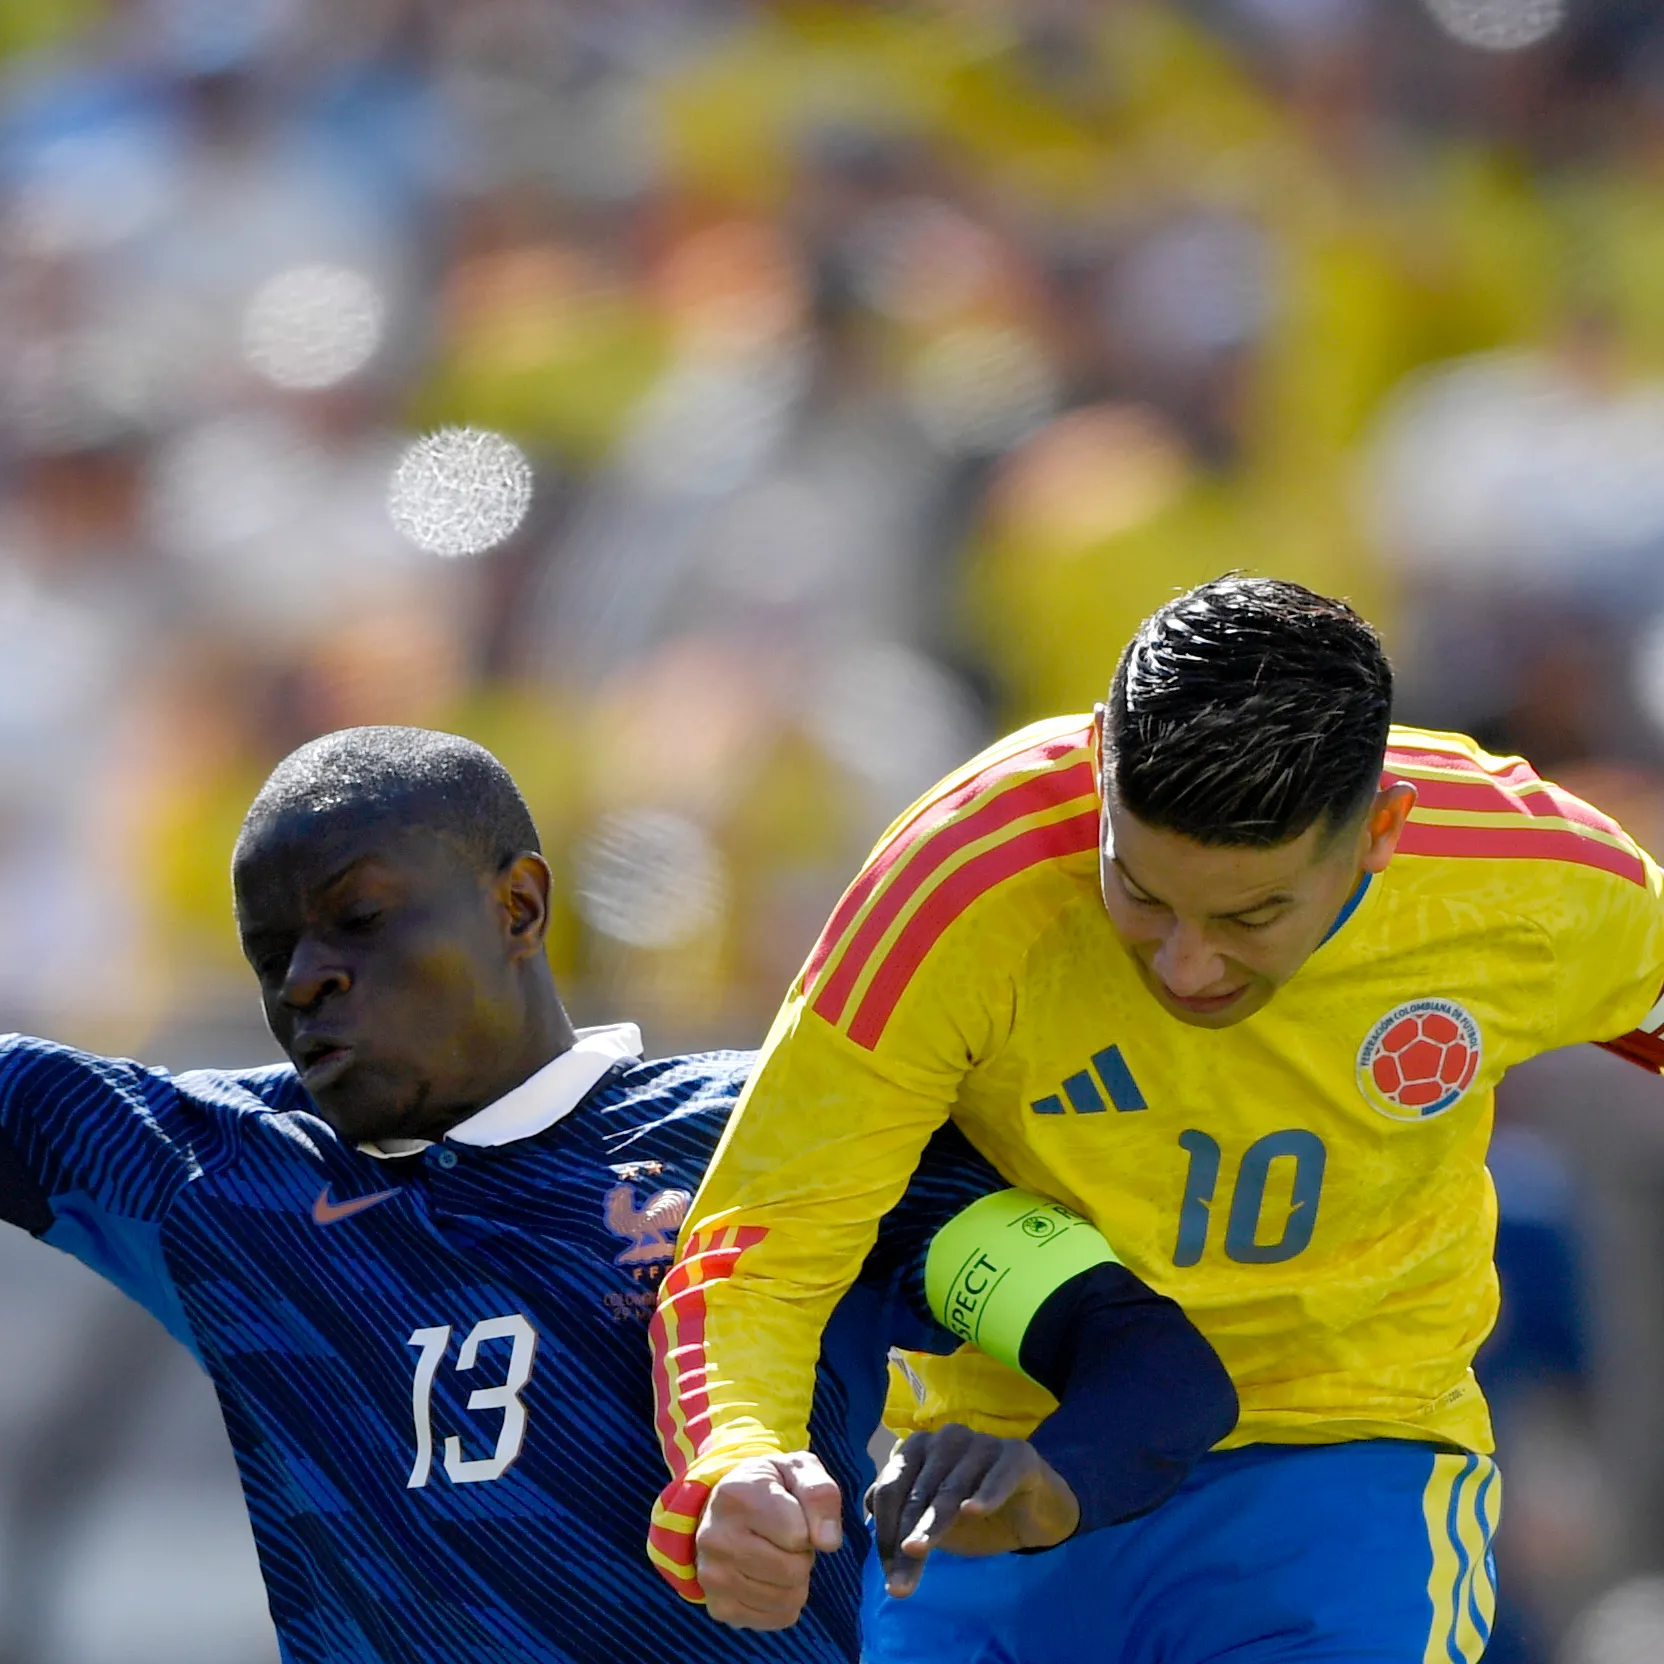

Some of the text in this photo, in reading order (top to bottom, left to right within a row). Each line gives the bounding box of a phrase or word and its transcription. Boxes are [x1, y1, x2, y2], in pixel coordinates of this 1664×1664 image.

[1394, 1001, 1452, 1020] COLOMBIANA
[1451, 1008, 1464, 1021] DE
[1172, 1128, 1327, 1268] 10
[951, 1253, 998, 1341] SPECT
[407, 1314, 539, 1489] 13
